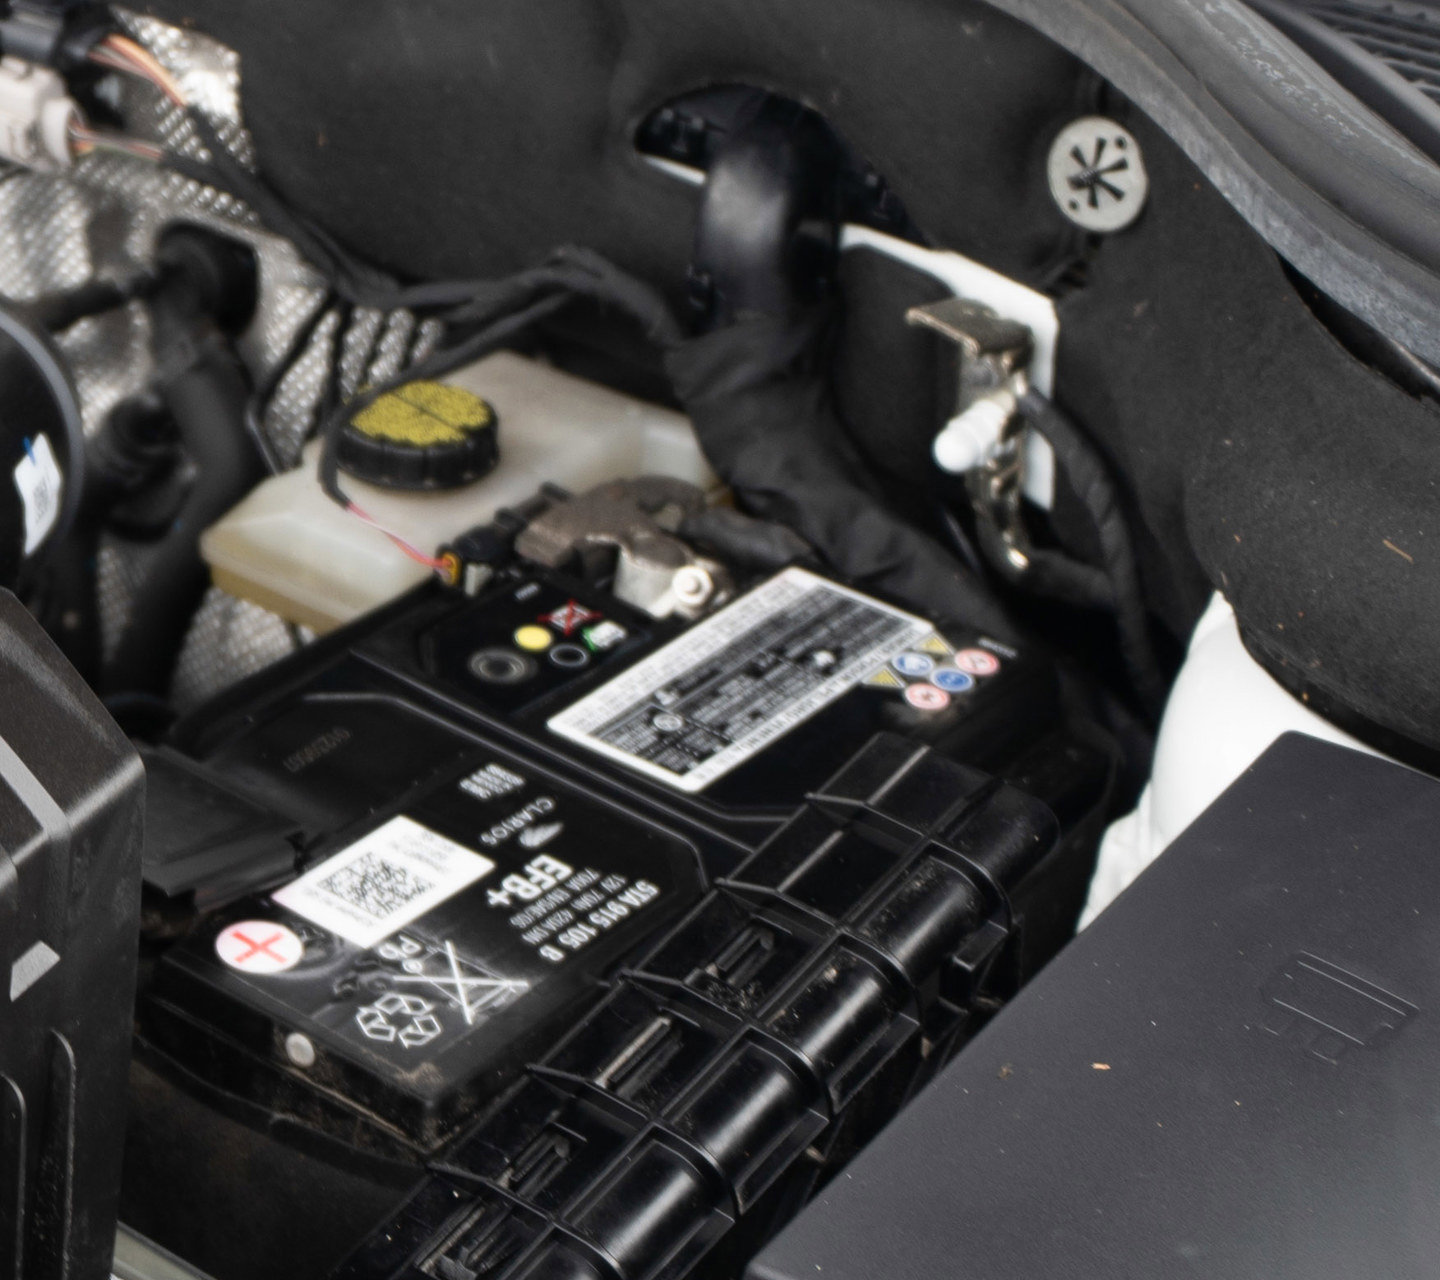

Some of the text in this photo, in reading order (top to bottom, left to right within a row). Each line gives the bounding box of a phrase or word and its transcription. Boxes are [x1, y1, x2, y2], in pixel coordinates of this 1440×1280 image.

[480, 796, 556, 846] CLARIOS
[487, 853, 573, 908] EFB+
[618, 879, 660, 909] 5TA
[589, 899, 629, 928] 915
[377, 933, 421, 960] Pb
[558, 919, 599, 950] 105
